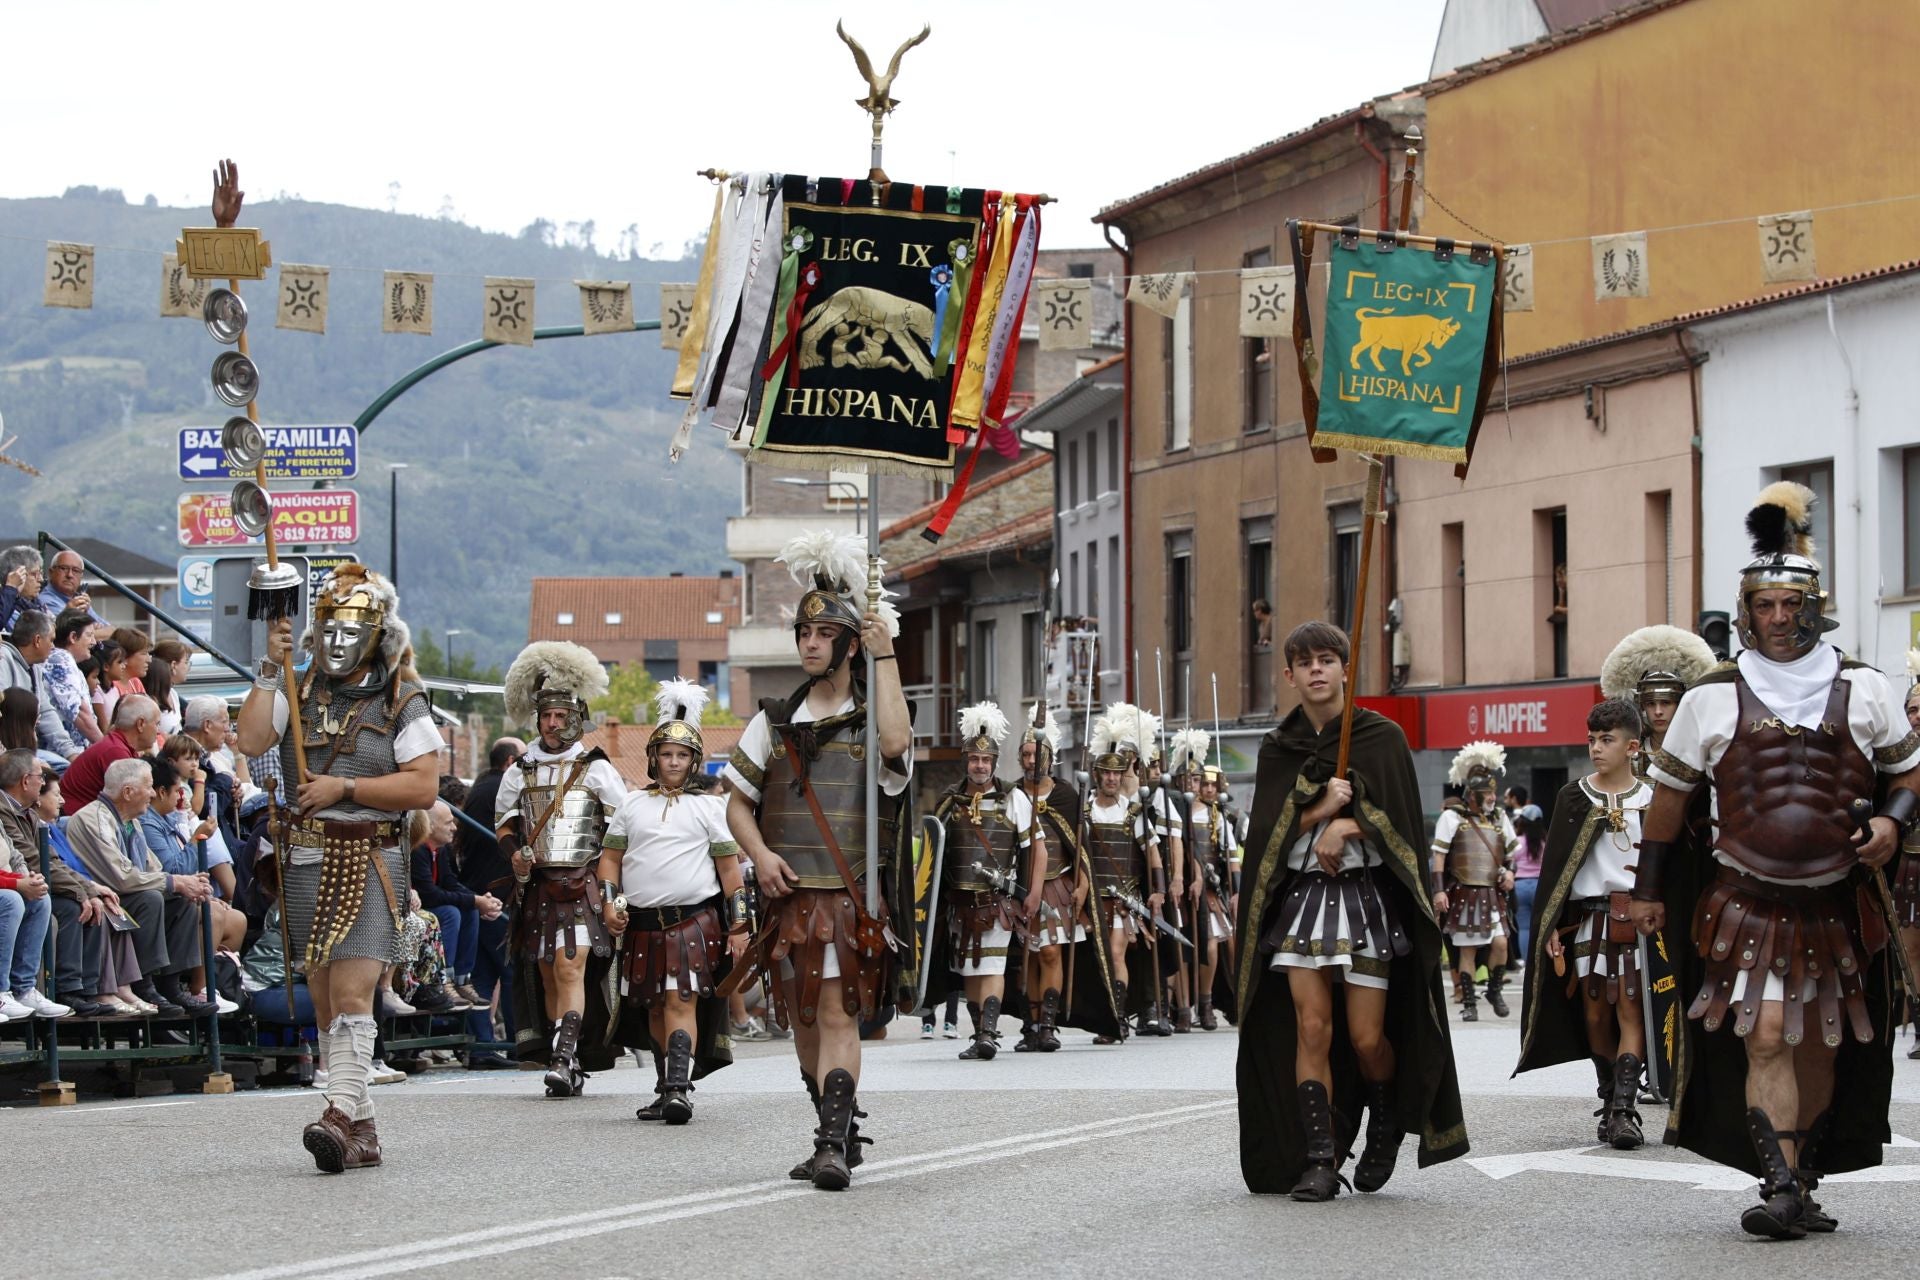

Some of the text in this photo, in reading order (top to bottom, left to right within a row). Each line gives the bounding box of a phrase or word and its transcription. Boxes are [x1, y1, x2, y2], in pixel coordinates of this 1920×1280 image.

[820, 236, 934, 268] LEG. IX
[1350, 374, 1445, 405] HISPANA
[781, 388, 941, 429] HISPANA
[184, 428, 352, 449] BAZ FAMILIA
[294, 448, 345, 457] REGALOS
[286, 457, 352, 467] FERRETERÍA
[301, 467, 343, 477] BOLSOS
[272, 494, 352, 508] ANÚNCIATE
[204, 507, 233, 518] TE VE
[274, 506, 349, 526] AQUÍ
[209, 518, 233, 528] NO
[284, 526, 352, 541] 619 472 758
[1484, 701, 1547, 734] MAPFRE
